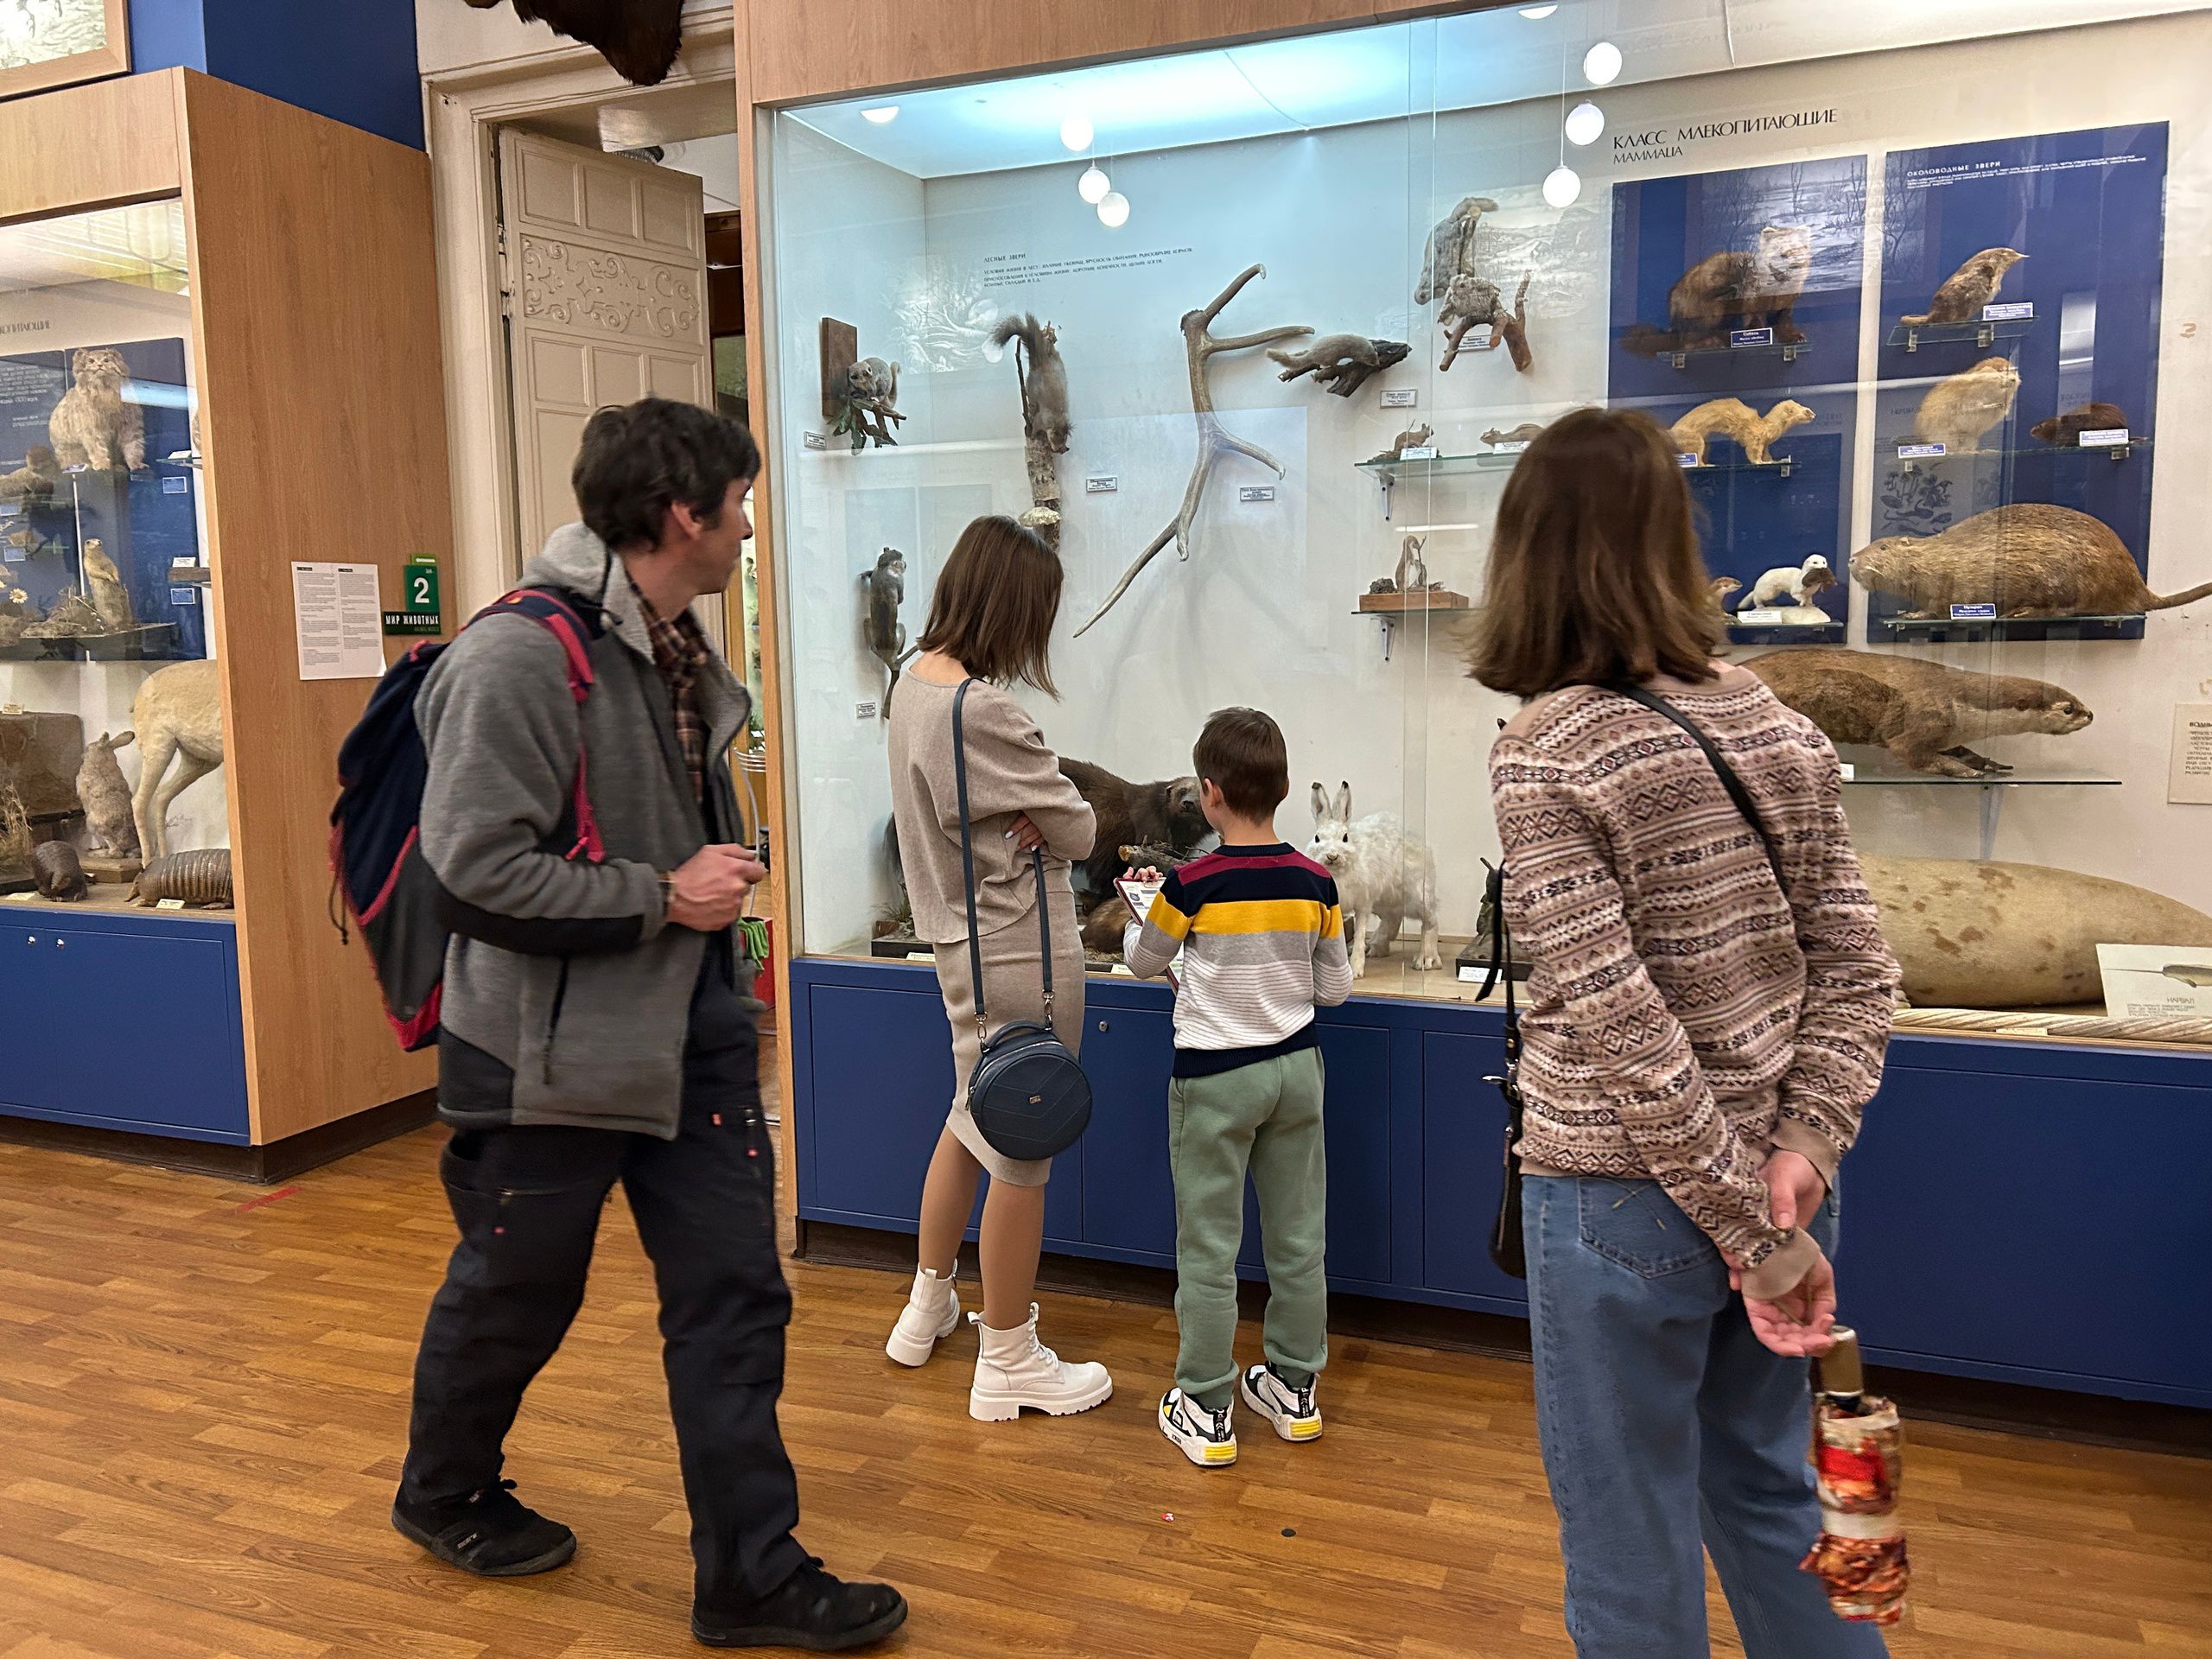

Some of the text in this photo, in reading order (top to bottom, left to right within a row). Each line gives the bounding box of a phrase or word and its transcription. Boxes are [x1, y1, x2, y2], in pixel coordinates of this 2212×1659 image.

[1613, 108, 1838, 149] КЛАСС МЛЕКОПИТАЮЩИЕ
[1613, 146, 1683, 164] MAMMALIA
[1907, 164, 1970, 177] ОКОЛОВОДНЫЕ
[1974, 161, 2001, 170] ЗВЕРИ
[414, 577, 429, 603] 2
[385, 615, 439, 625] МИР ЖИВОТНЫХ
